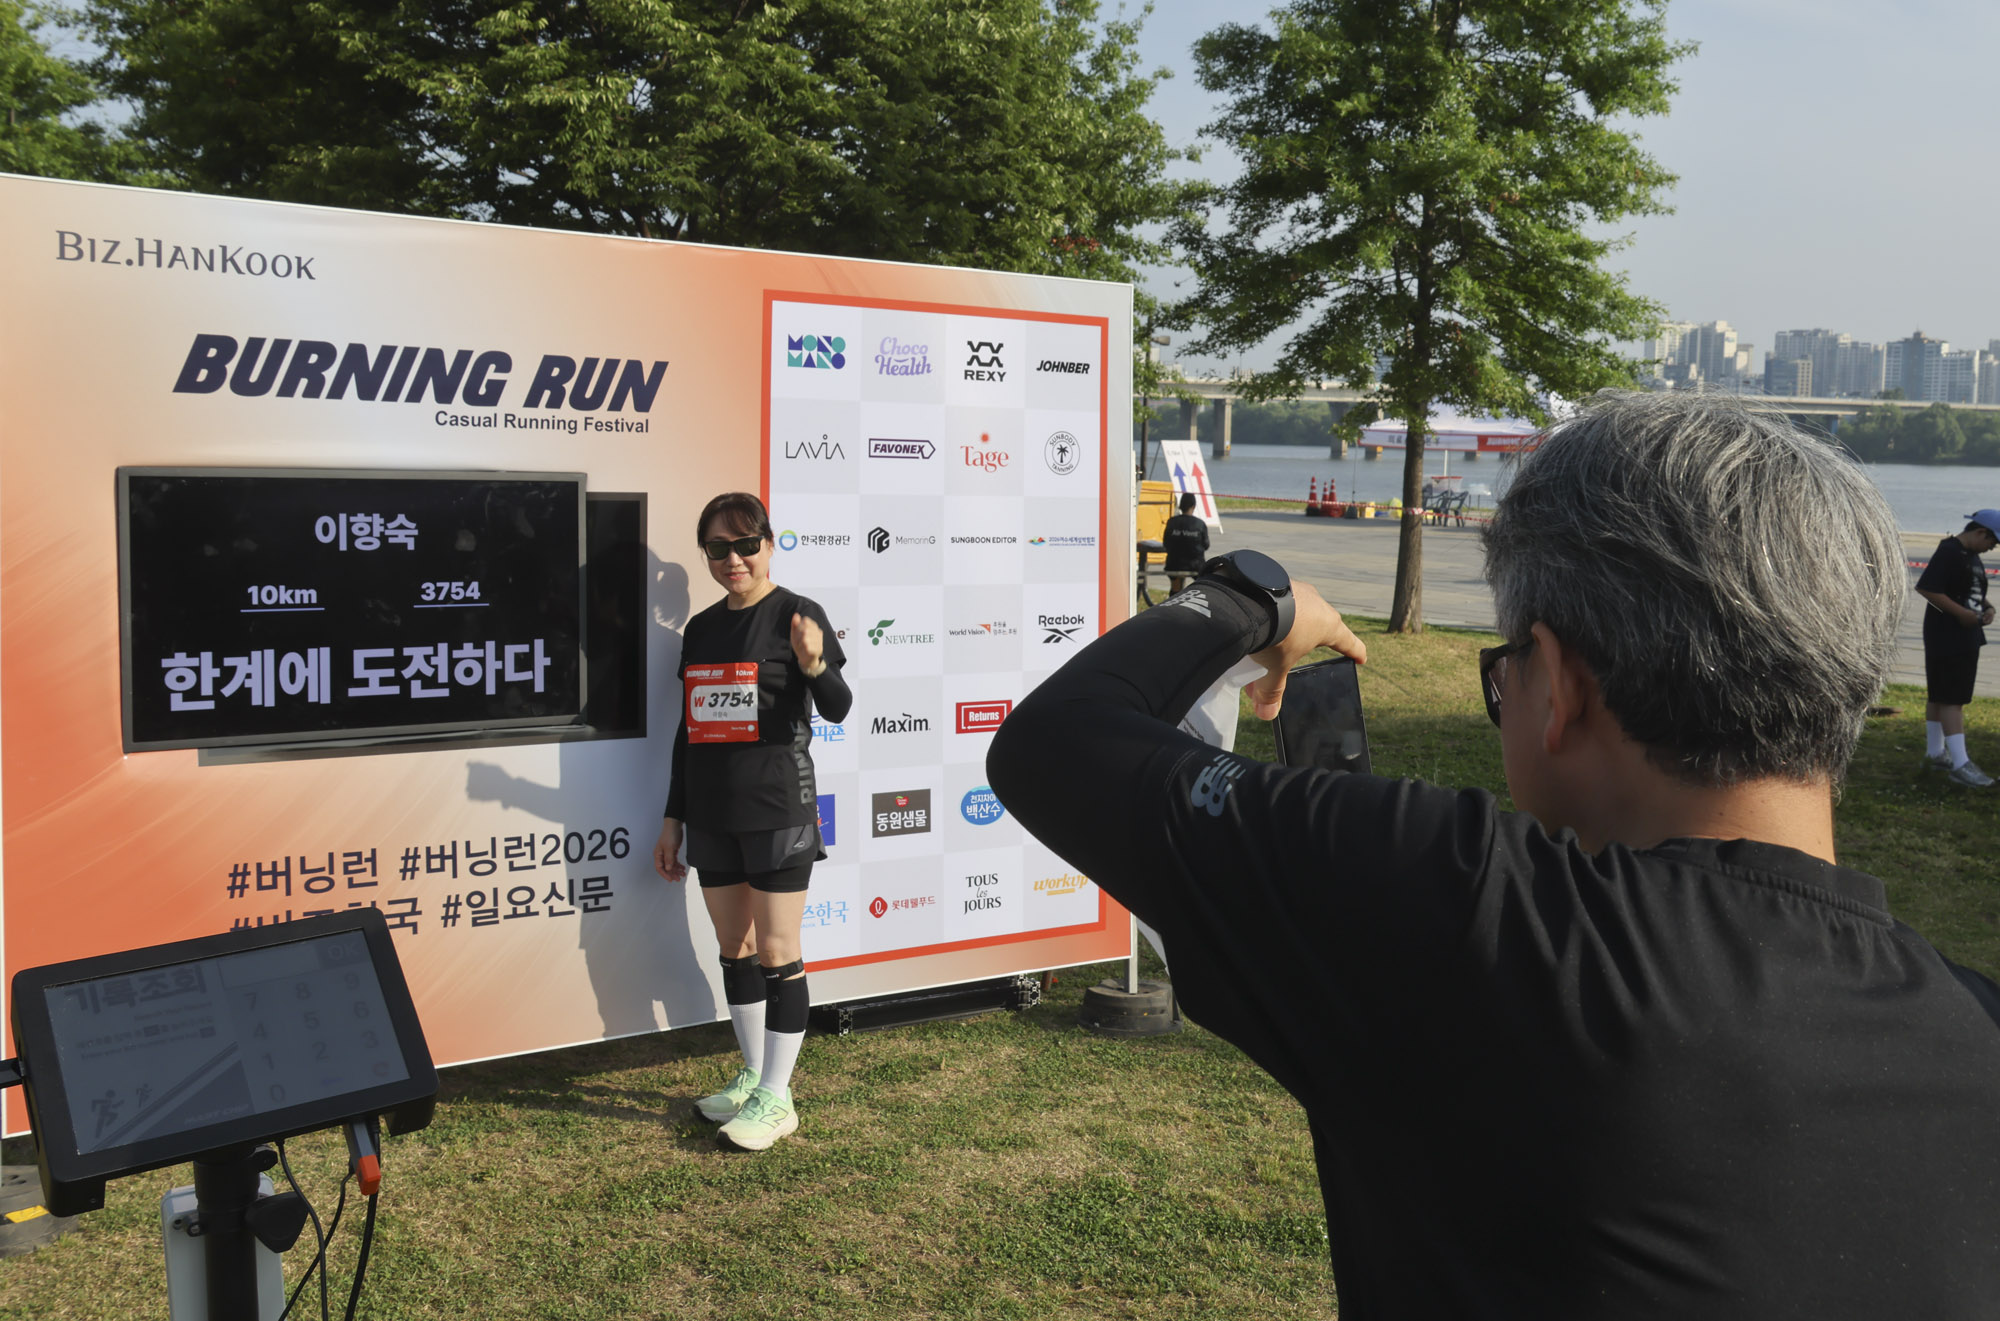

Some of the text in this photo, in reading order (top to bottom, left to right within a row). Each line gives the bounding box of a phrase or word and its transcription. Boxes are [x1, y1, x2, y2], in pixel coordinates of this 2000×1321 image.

[880, 336, 928, 356] Choco
[172, 333, 668, 413] BURNING RUN
[875, 354, 932, 376] Health
[1036, 360, 1090, 375] JOHNBER
[964, 369, 1007, 382] REXY
[435, 411, 650, 434] Casual Running Festival
[1049, 433, 1076, 447] SUNBODY
[873, 443, 925, 455] FAVONEX
[960, 446, 1009, 473] Tage
[1051, 462, 1074, 473] TANNING
[314, 513, 418, 551] 이향숙
[895, 535, 936, 545] MemorinG
[950, 536, 1017, 544] SUNGBOON EDITOR
[801, 535, 850, 546] 한국환경공단
[247, 581, 481, 605] 10km 3754
[1038, 614, 1085, 626] Reebok
[885, 633, 935, 645] NEWTREE
[968, 628, 985, 636] Vision
[161, 638, 551, 712] 한계에 도전하다
[694, 692, 754, 708] W 3754
[871, 713, 931, 735] Maxim
[968, 711, 1000, 722] Returns
[966, 802, 1001, 819] 백산수
[876, 809, 927, 832] 동원샘물
[227, 827, 630, 899] #버닝런 #버닝런2026
[966, 873, 998, 888] TOUS
[976, 887, 987, 898] les
[441, 875, 614, 928] #일요신문
[892, 895, 936, 910] 롯데웰푸드
[963, 896, 1002, 914] JOURS
[802, 901, 849, 926] 즈한국
[64, 964, 207, 1015] 기록조회
